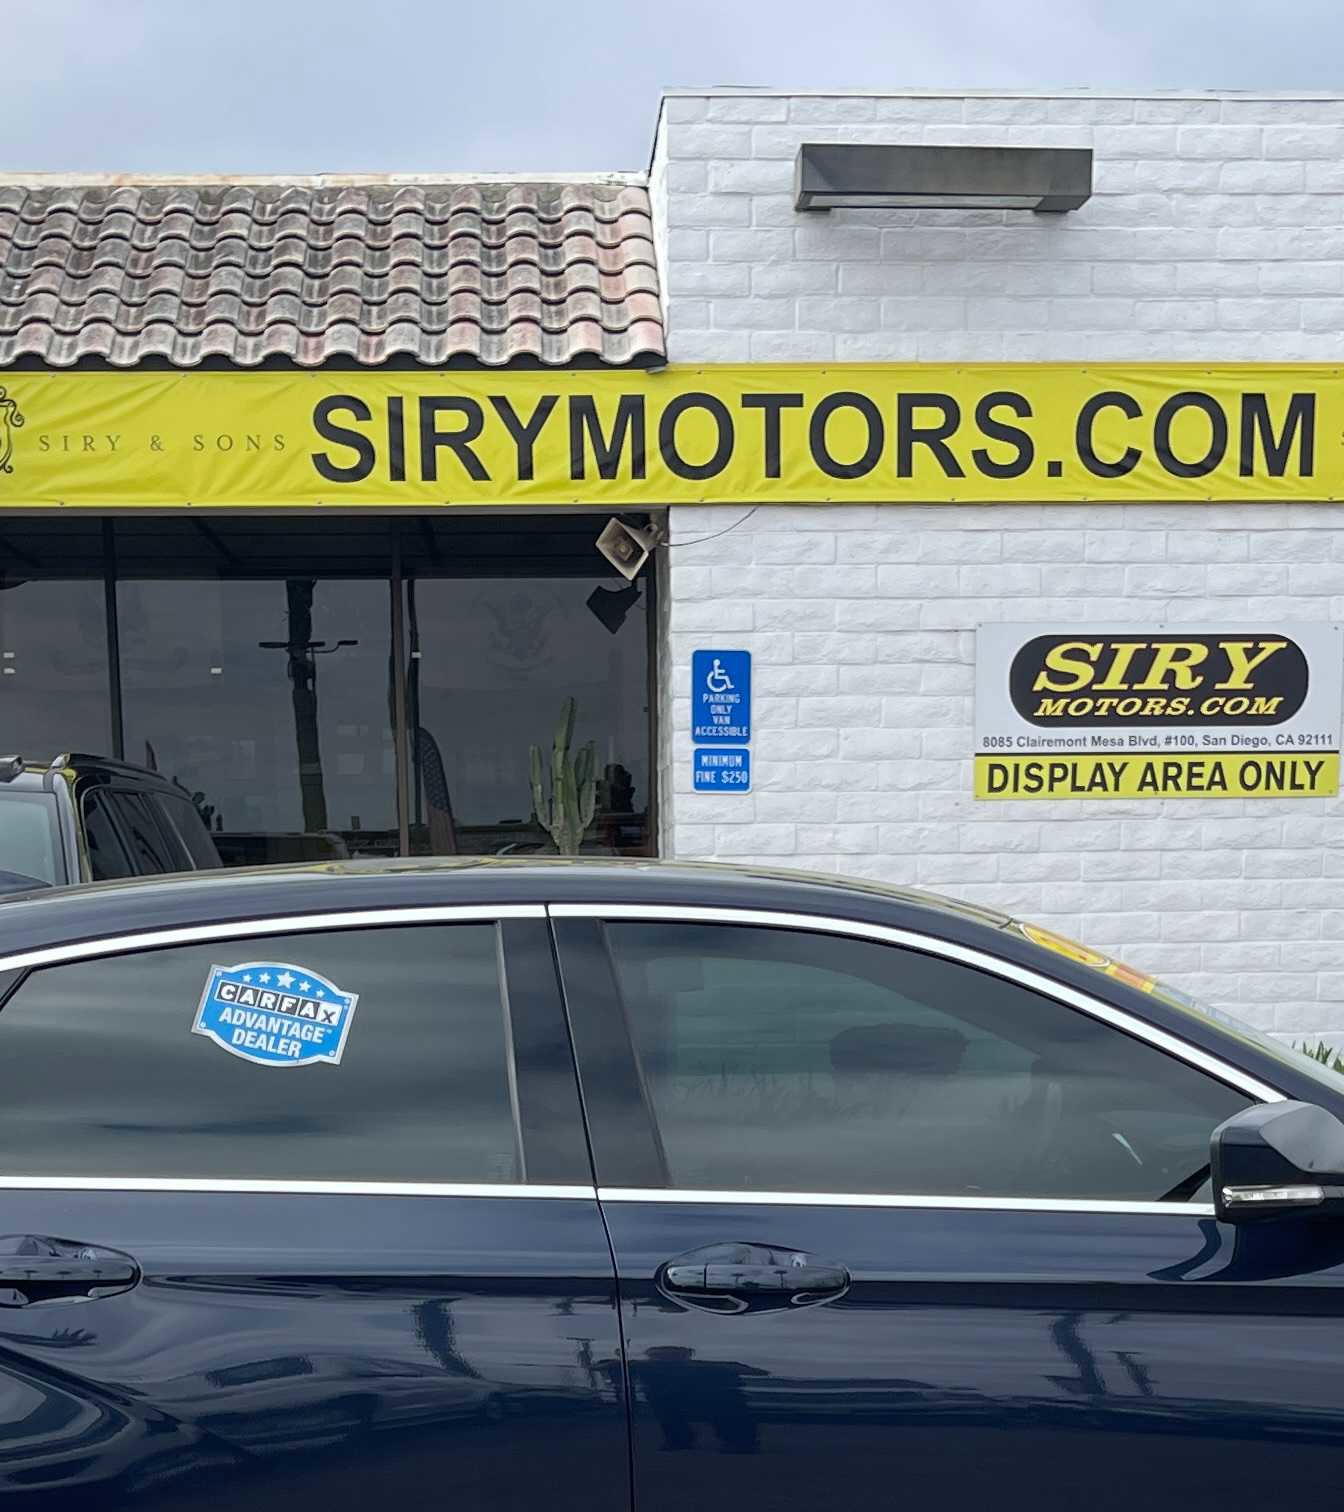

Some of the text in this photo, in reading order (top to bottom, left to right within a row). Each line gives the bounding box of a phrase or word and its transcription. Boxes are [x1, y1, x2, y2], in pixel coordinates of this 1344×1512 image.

[38, 433, 287, 452] SIRY & SONS
[311, 391, 1317, 484] SIRYMOTORS.COM
[1032, 640, 1288, 693] SIRY
[702, 693, 741, 704] PARKING
[1033, 695, 1285, 718] MOTORS.COM
[710, 704, 733, 715] ONLY
[712, 715, 731, 725] VAN
[695, 726, 749, 737] ACCESSIBLE
[982, 733, 1334, 750] 8085 Clairemont Mesa Blvd, #100, San Diego, CA 92111
[701, 754, 743, 768] MINIMUM
[696, 770, 748, 785] FINE $250
[987, 760, 1326, 794] DISPLAY AREA ONLY
[217, 981, 339, 1025] CARFAX
[218, 1006, 325, 1043] ADVANTAGE
[232, 1028, 302, 1058] DEALER
